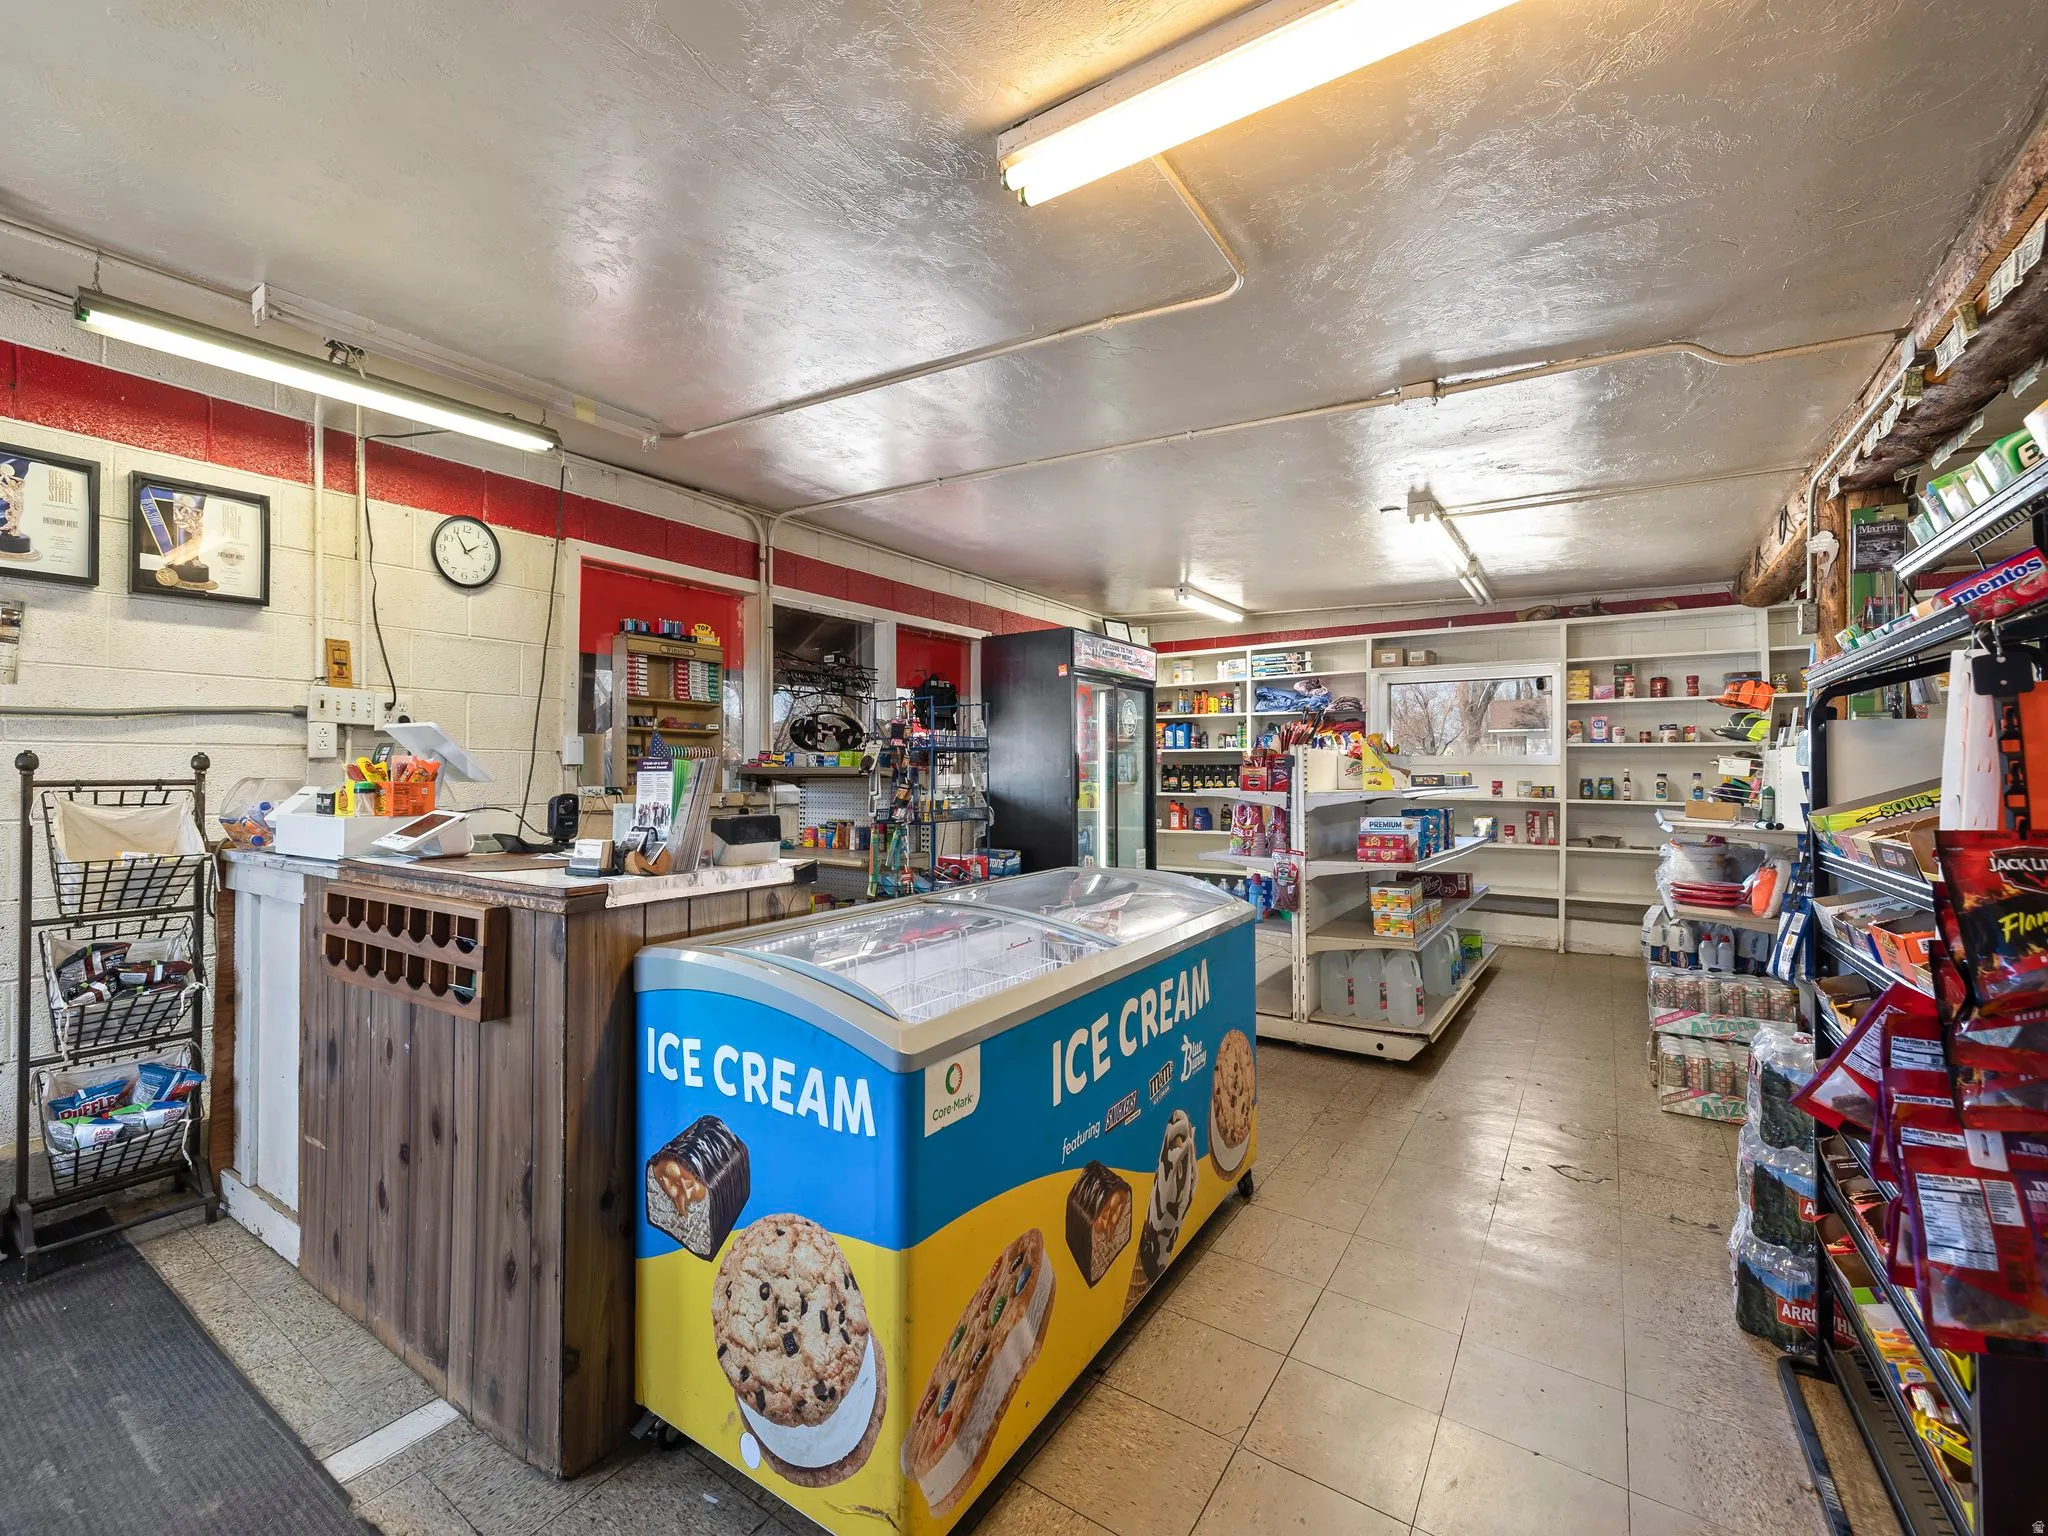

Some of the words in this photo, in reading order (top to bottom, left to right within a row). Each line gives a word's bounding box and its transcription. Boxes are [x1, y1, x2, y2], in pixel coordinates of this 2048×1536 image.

[48, 469, 67, 488] BEST
[48, 486, 73, 504] STATE
[463, 525, 472, 534] 12
[1859, 524, 1898, 534] Martin
[443, 533, 454, 542] 10
[439, 544, 446, 552] 9
[482, 540, 489, 549] 2
[442, 556, 449, 564] 8
[485, 553, 491, 561] 3
[451, 566, 457, 575] 7
[472, 570, 479, 579] 5
[461, 572, 468, 580] 6
[1950, 557, 2043, 605] mentos
[697, 624, 709, 632] TOP
[1102, 643, 1120, 652] WELCOME
[1345, 764, 1362, 776] Spit
[1880, 795, 1933, 817] SOUR
[1369, 820, 1402, 829] PREMIUM
[1989, 858, 2031, 872] JACK
[2031, 858, 2048, 872] LI
[1859, 902, 1873, 910] mints
[1053, 1012, 1111, 1107] ICE
[1119, 958, 1210, 1057] CREAM
[1690, 1020, 1758, 1038] AriZona
[1893, 1037, 1926, 1046] Nutrition
[647, 1027, 703, 1088] ICE
[713, 1045, 876, 1137] CREAM
[1895, 1094, 1929, 1104] Nutrition
[1930, 1097, 1951, 1106] Facts
[1902, 1127, 1936, 1138] Nutrition
[1937, 1133, 1958, 1142] Facts
[1061, 1120, 1101, 1164] featuring
[1917, 1174, 1950, 1183] Nutrition
[1951, 1177, 1972, 1185] Facts
